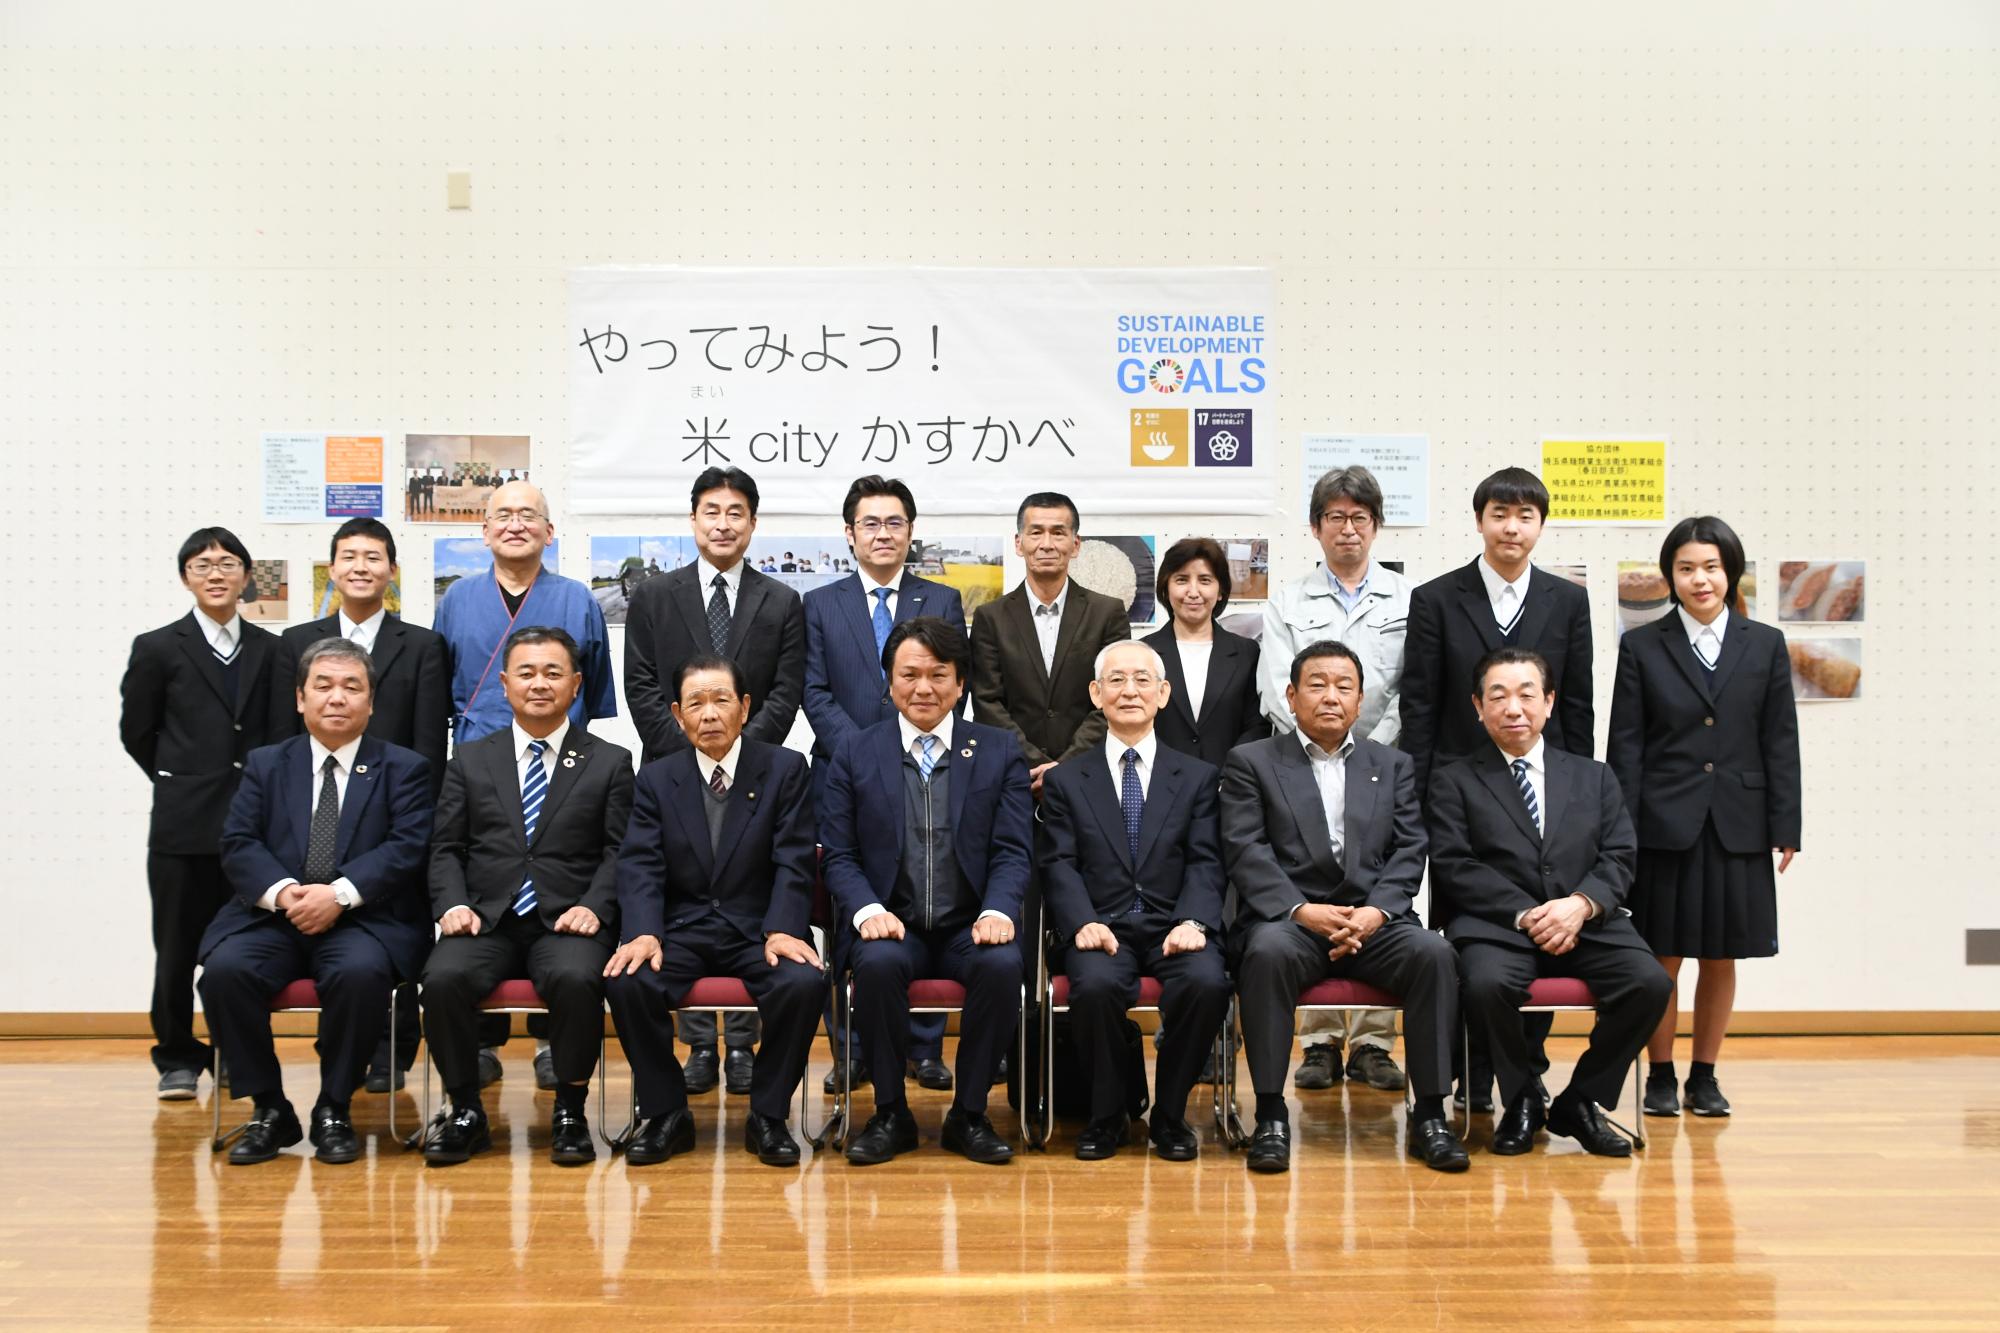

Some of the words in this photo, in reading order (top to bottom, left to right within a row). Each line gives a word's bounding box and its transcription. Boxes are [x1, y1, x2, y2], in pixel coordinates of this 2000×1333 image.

[1117, 315, 1265, 333] SUSTAINABLE
[579, 323, 943, 375] やってみよう！
[1117, 337, 1265, 354] DEVELOPMENT
[1117, 358, 1266, 394] GOALS
[690, 385, 725, 399] まい
[1134, 412, 1142, 426] 2
[1197, 412, 1209, 426] 17
[681, 416, 732, 468] 米
[748, 420, 839, 468] city
[862, 416, 1075, 465] かすかべ
[1549, 494, 1594, 502] 事組合法人
[1548, 508, 1663, 517] 玉県春日部農林振興センター
